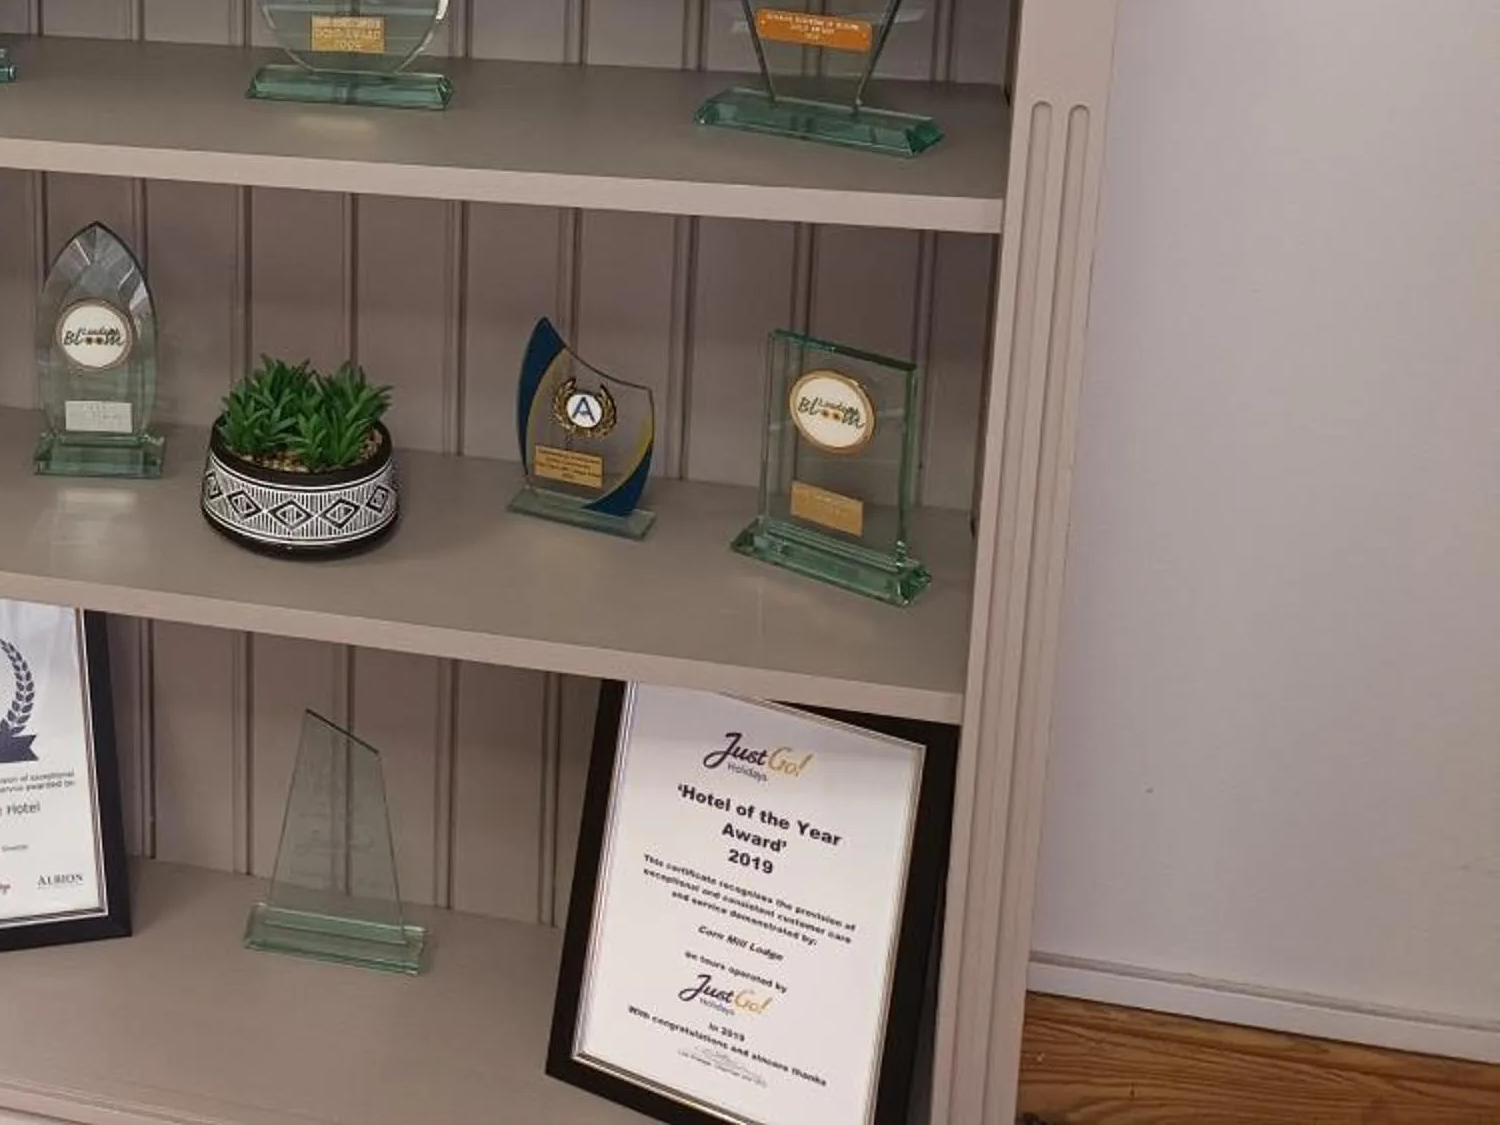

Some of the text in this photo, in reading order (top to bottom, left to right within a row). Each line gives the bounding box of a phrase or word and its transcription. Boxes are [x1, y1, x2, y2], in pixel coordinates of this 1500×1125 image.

[572, 396, 597, 424] A
[26, 779, 62, 792] awarded
[727, 761, 768, 782] Holidays
[7, 801, 41, 815] Hotel
[736, 804, 755, 819] of
[760, 810, 790, 830] the
[797, 819, 842, 846] Year
[728, 848, 774, 874] 2019
[37, 873, 84, 887] ALBION
[644, 853, 843, 928] This certificate recognises the provision
[643, 867, 852, 944] exceptional and consistent customer care
[671, 890, 690, 902] and
[692, 896, 728, 916] service
[729, 908, 800, 940] demonstrated
[698, 925, 784, 962] Corn Mill Lodge
[700, 955, 788, 994] tours operated by
[628, 1004, 651, 1020] With
[652, 1014, 729, 1050] congratulations
[730, 1045, 750, 1058] and
[752, 1053, 790, 1073] sincere
[791, 1066, 828, 1088] thanks
